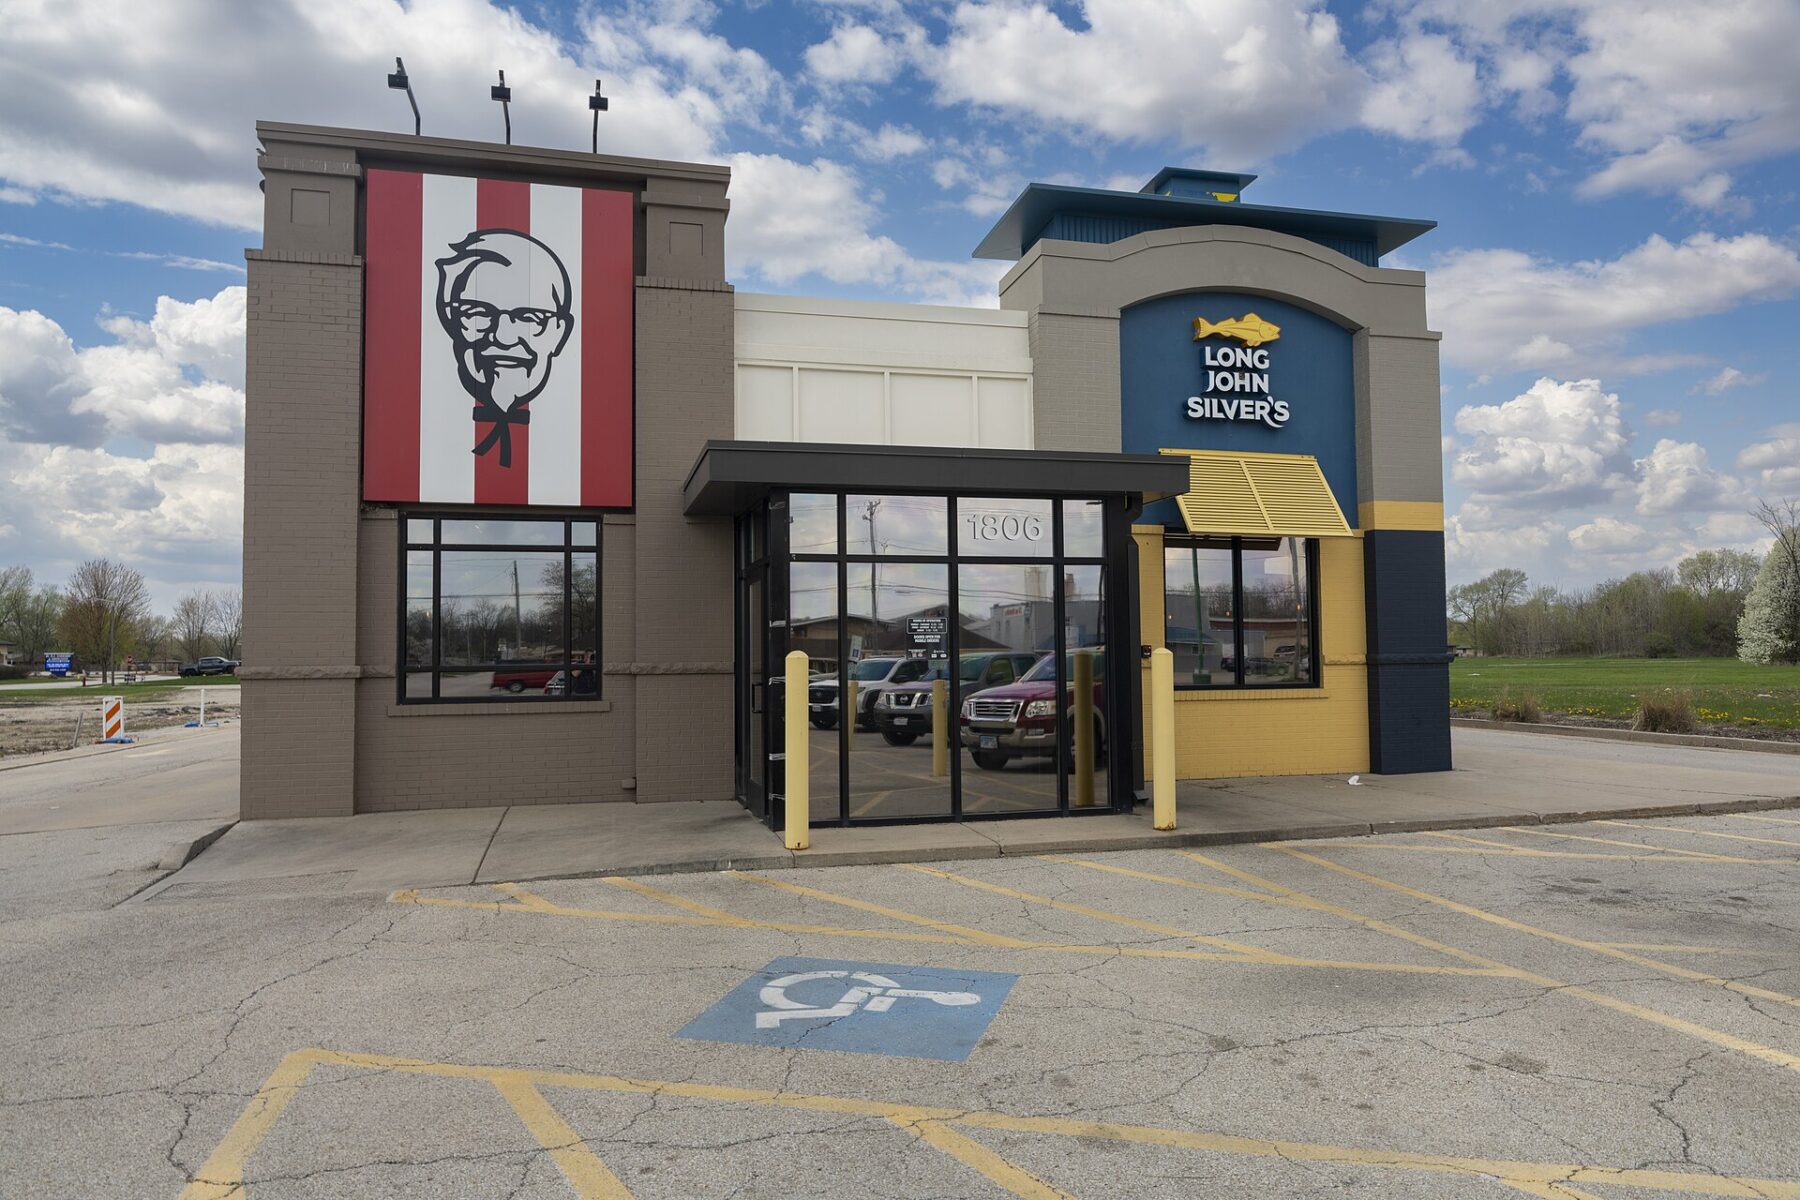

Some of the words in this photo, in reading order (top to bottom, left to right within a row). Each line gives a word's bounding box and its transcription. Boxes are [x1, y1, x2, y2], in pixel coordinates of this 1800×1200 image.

[1204, 346, 1270, 370] LONG
[1205, 370, 1270, 394] JOHN
[1187, 395, 1291, 428] SILVER'S
[967, 514, 1042, 541] 1806
